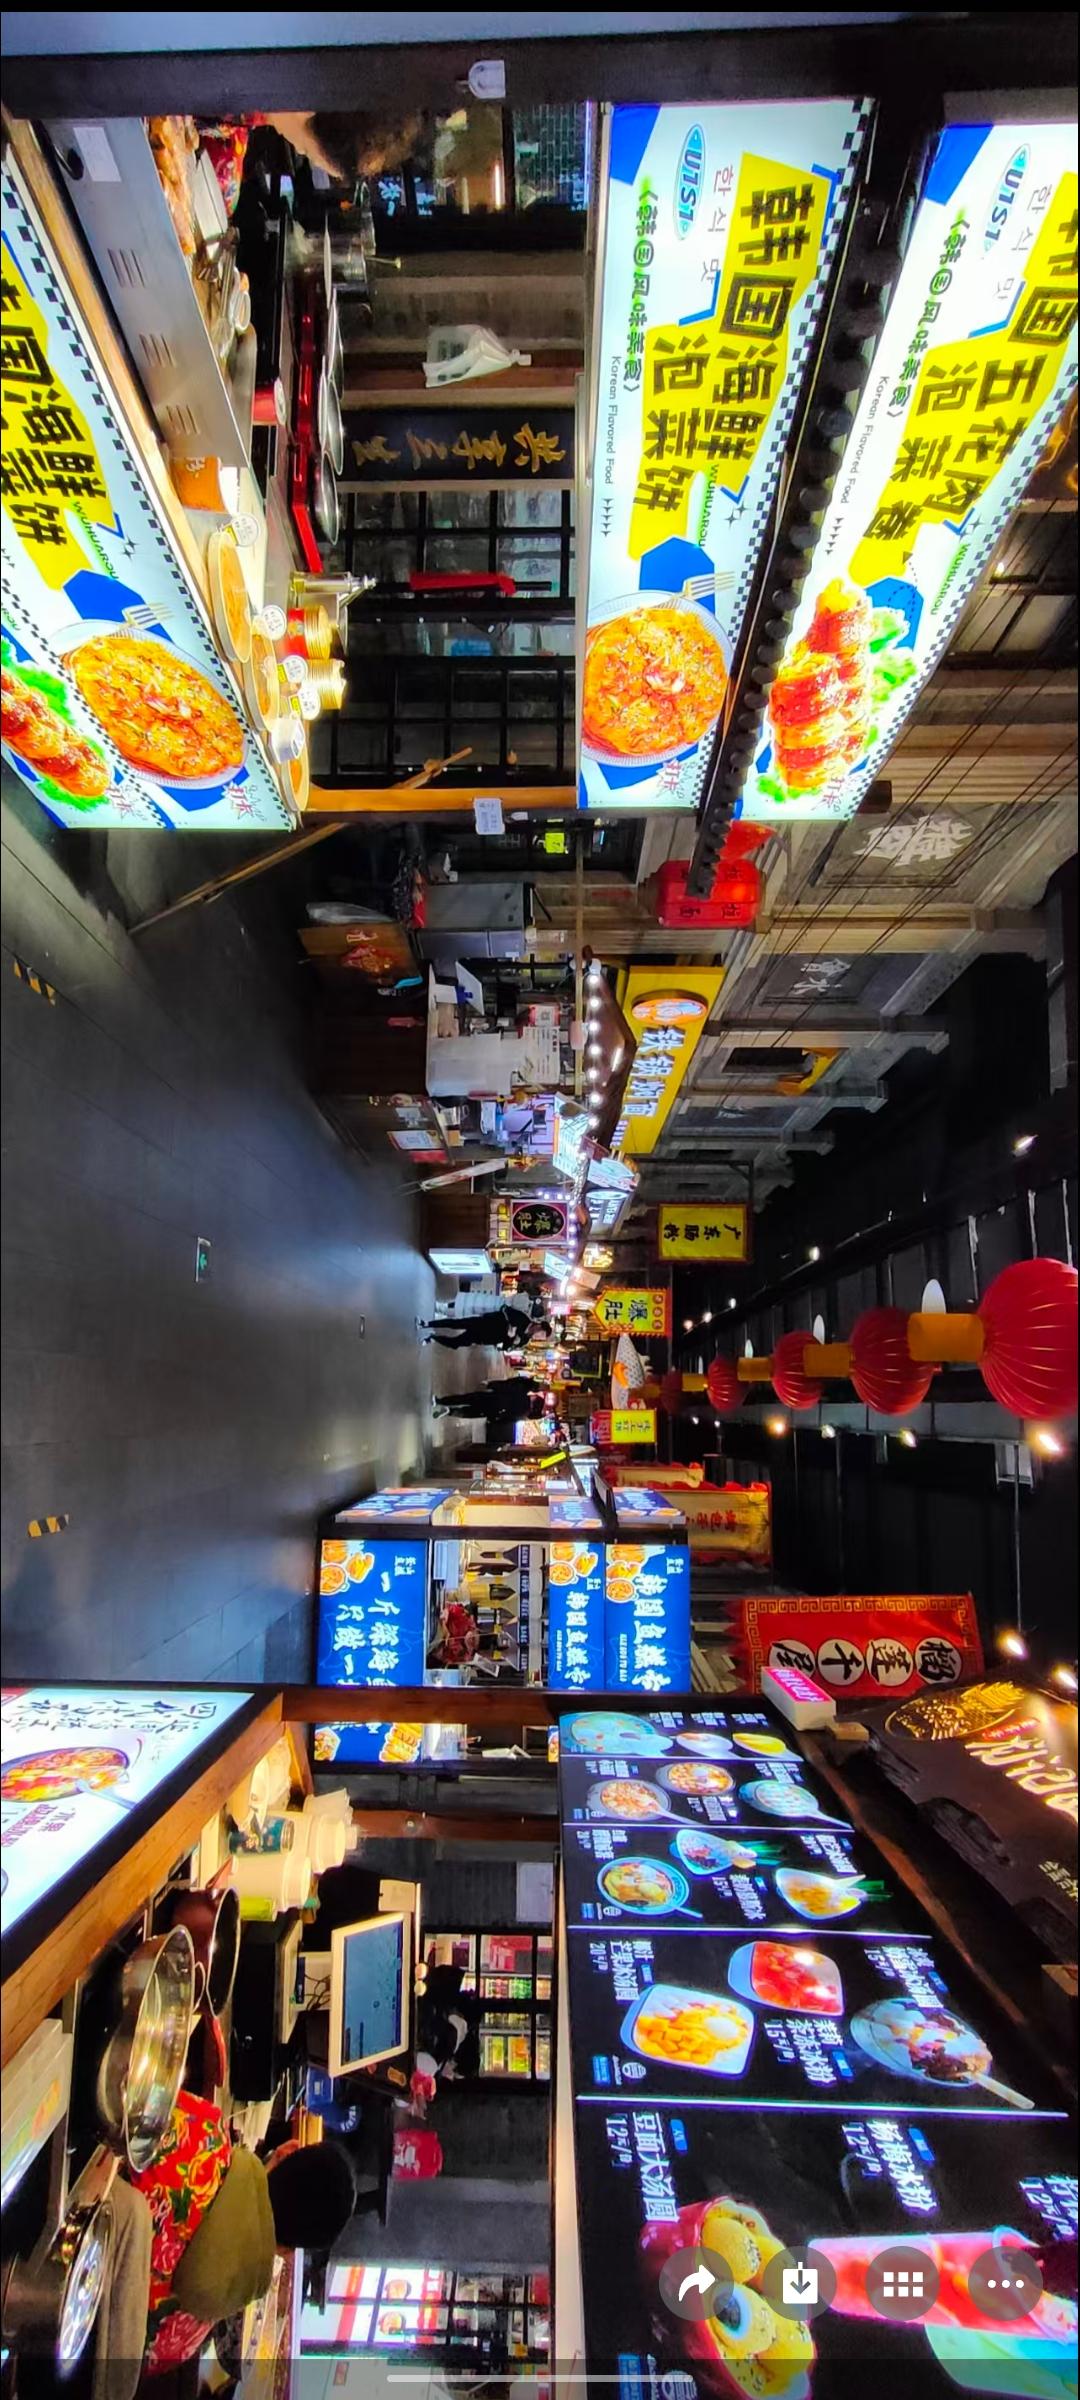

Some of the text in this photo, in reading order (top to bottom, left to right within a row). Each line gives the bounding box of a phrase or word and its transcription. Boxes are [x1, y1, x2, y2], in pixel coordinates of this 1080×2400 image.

[678, 148, 703, 223] U1S1
[983, 168, 1025, 241] U1S1
[697, 184, 816, 461] 韩国海鲜
[604, 355, 622, 485] Korean Flavored Food
[633, 335, 711, 512] 泡菜饼
[839, 375, 890, 505] Korean Flavored Food
[862, 364, 978, 541] 泡菜卷
[1, 407, 68, 546] 菜饼
[621, 1027, 686, 1118] 铁锅焖面
[663, 1222, 742, 1243] 广东肠粉
[604, 1299, 649, 1323] 爆肚
[610, 1940, 640, 2001] 芒果冰汤圆
[785, 2019, 837, 2084] 茶冻冰粉
[632, 2111, 681, 2223] 豆面大汤圆
[865, 2120, 938, 2212] 杨梅冰粉
